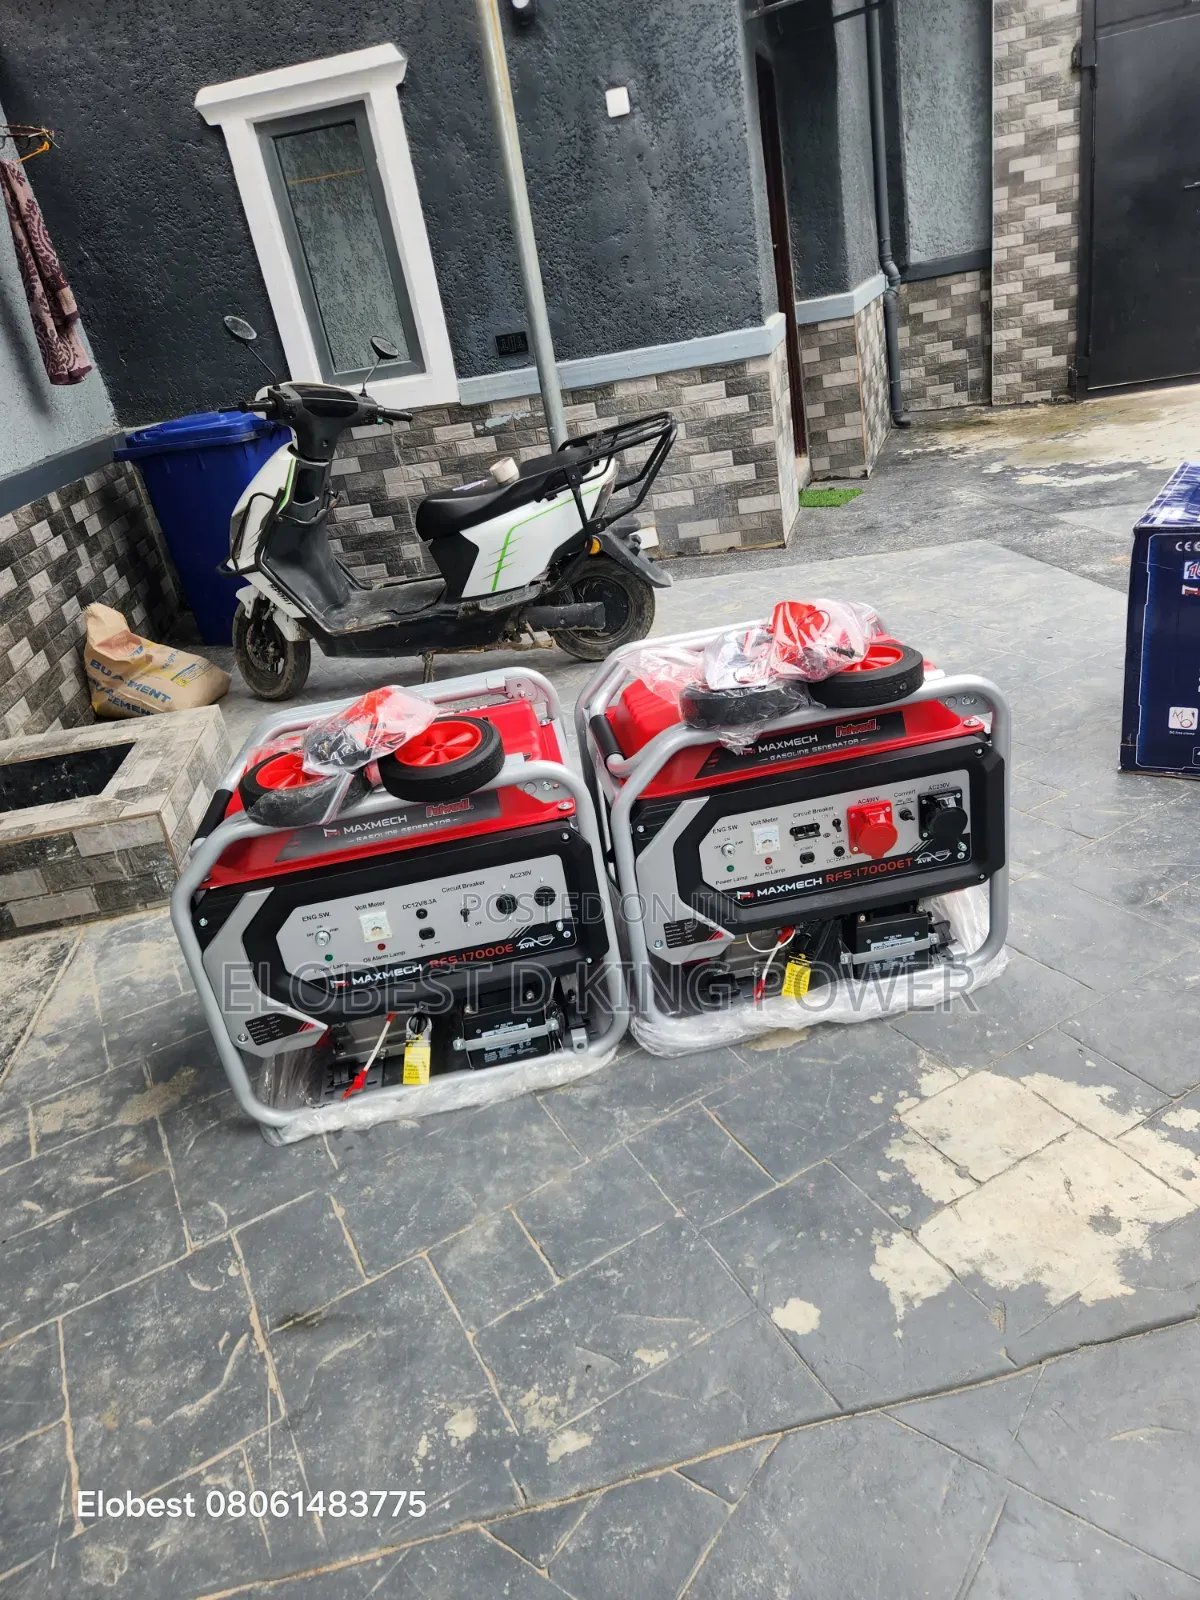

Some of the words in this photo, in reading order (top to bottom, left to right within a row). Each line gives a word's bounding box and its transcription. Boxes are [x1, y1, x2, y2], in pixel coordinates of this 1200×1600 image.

[758, 734, 818, 753] MAXMECH
[769, 748, 810, 761] GASOLINE
[811, 738, 860, 752] GENERATOR
[893, 789, 916, 798] Convert
[812, 806, 835, 815] Breaker
[343, 814, 408, 835] MAXMECH
[441, 883, 462, 894] Circuit
[461, 879, 486, 890] Breaker
[756, 876, 823, 898] MAXMECH
[825, 857, 914, 884] RFS-17000ET
[352, 963, 424, 986] MAXMECH
[428, 943, 515, 969] RFS-17000E
